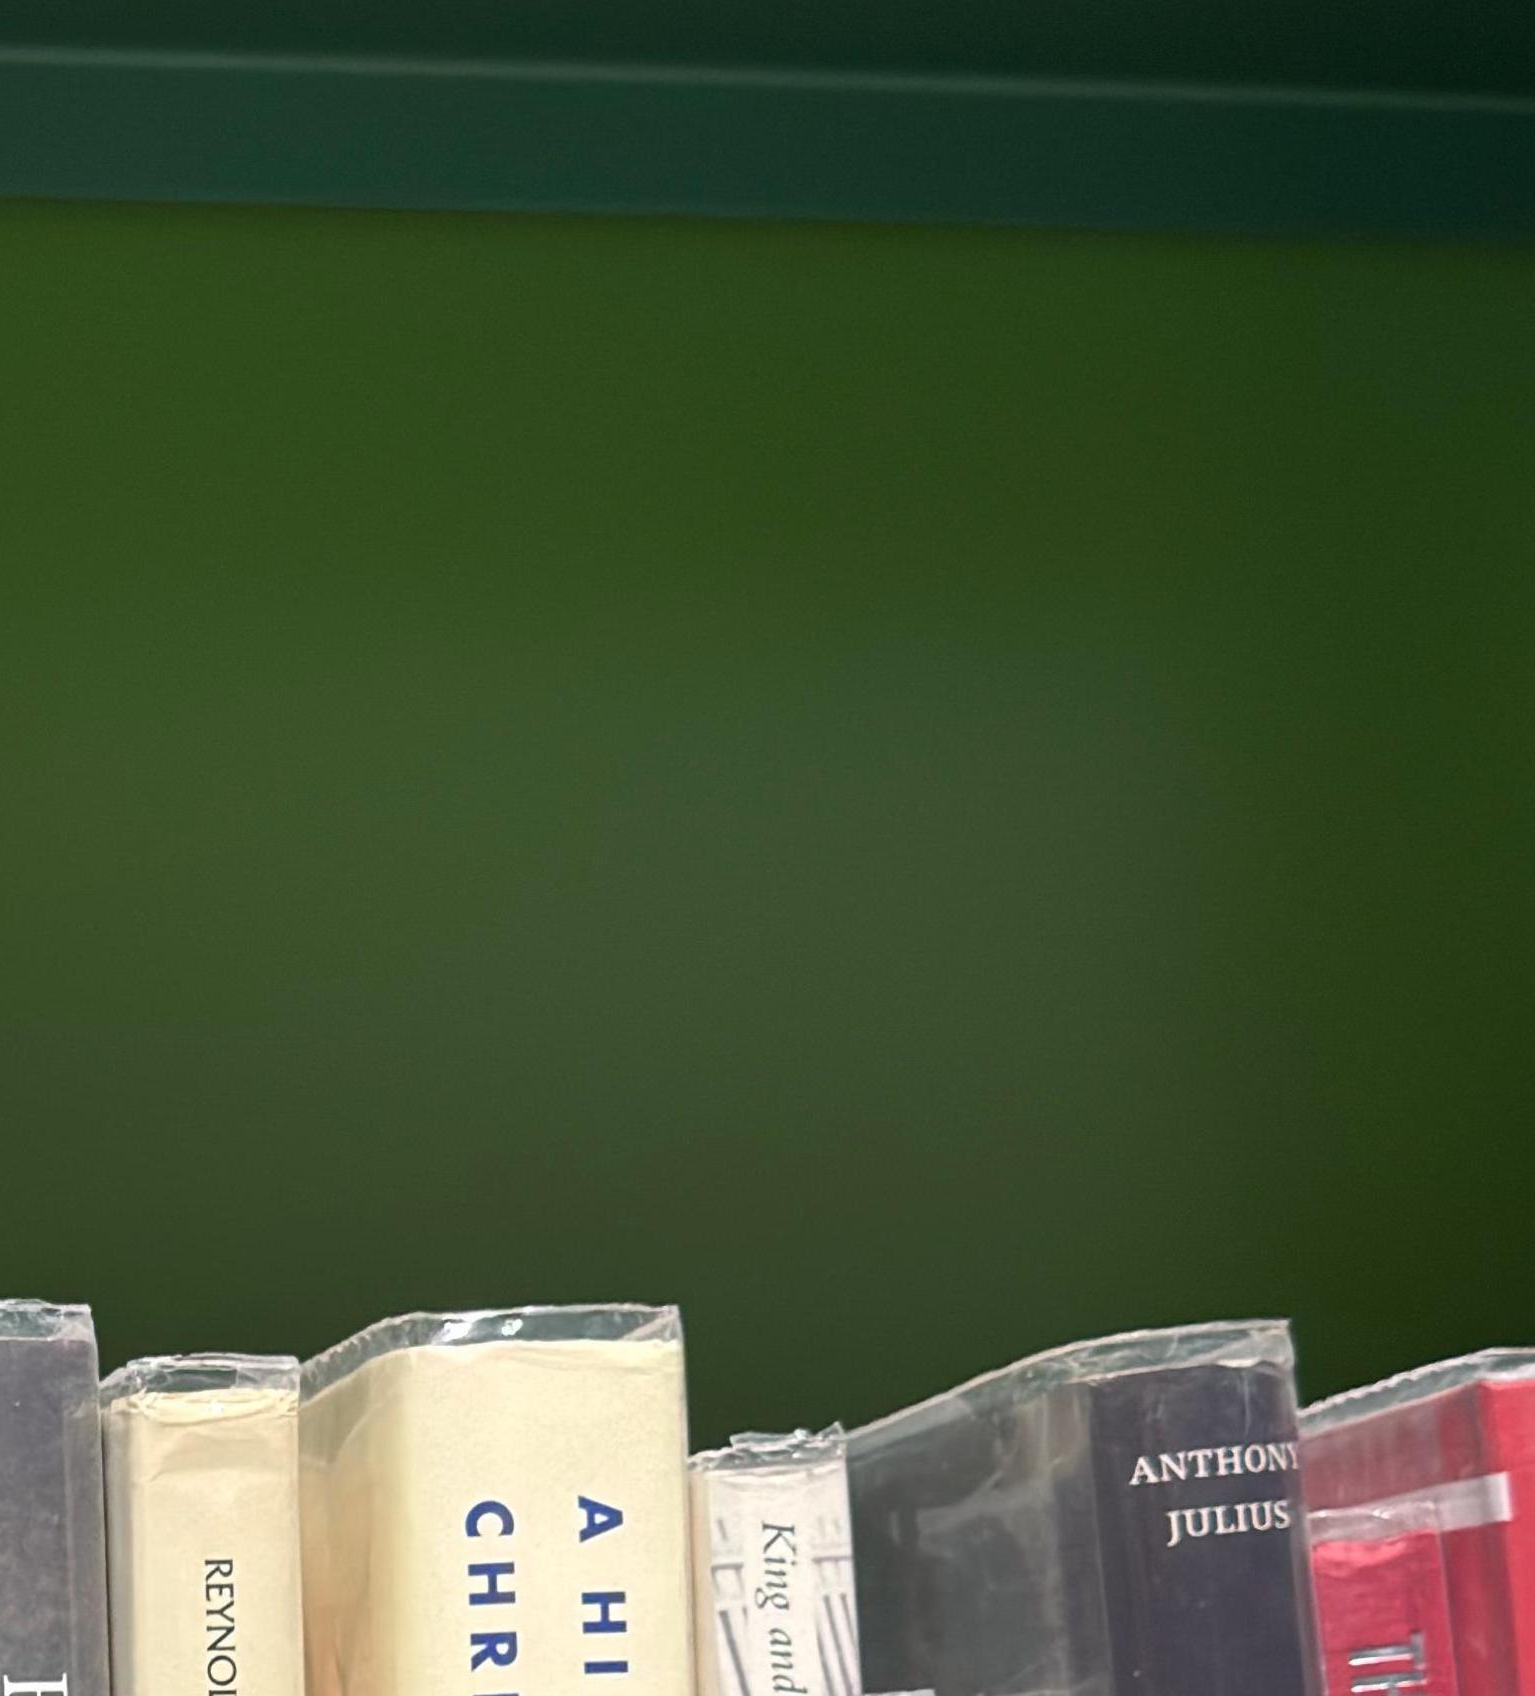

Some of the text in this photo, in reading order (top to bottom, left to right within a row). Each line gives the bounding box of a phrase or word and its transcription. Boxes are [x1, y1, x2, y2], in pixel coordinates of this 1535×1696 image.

[577, 1496, 625, 1544] A
[753, 1521, 797, 1613] King
[767, 1626, 808, 1695] and
